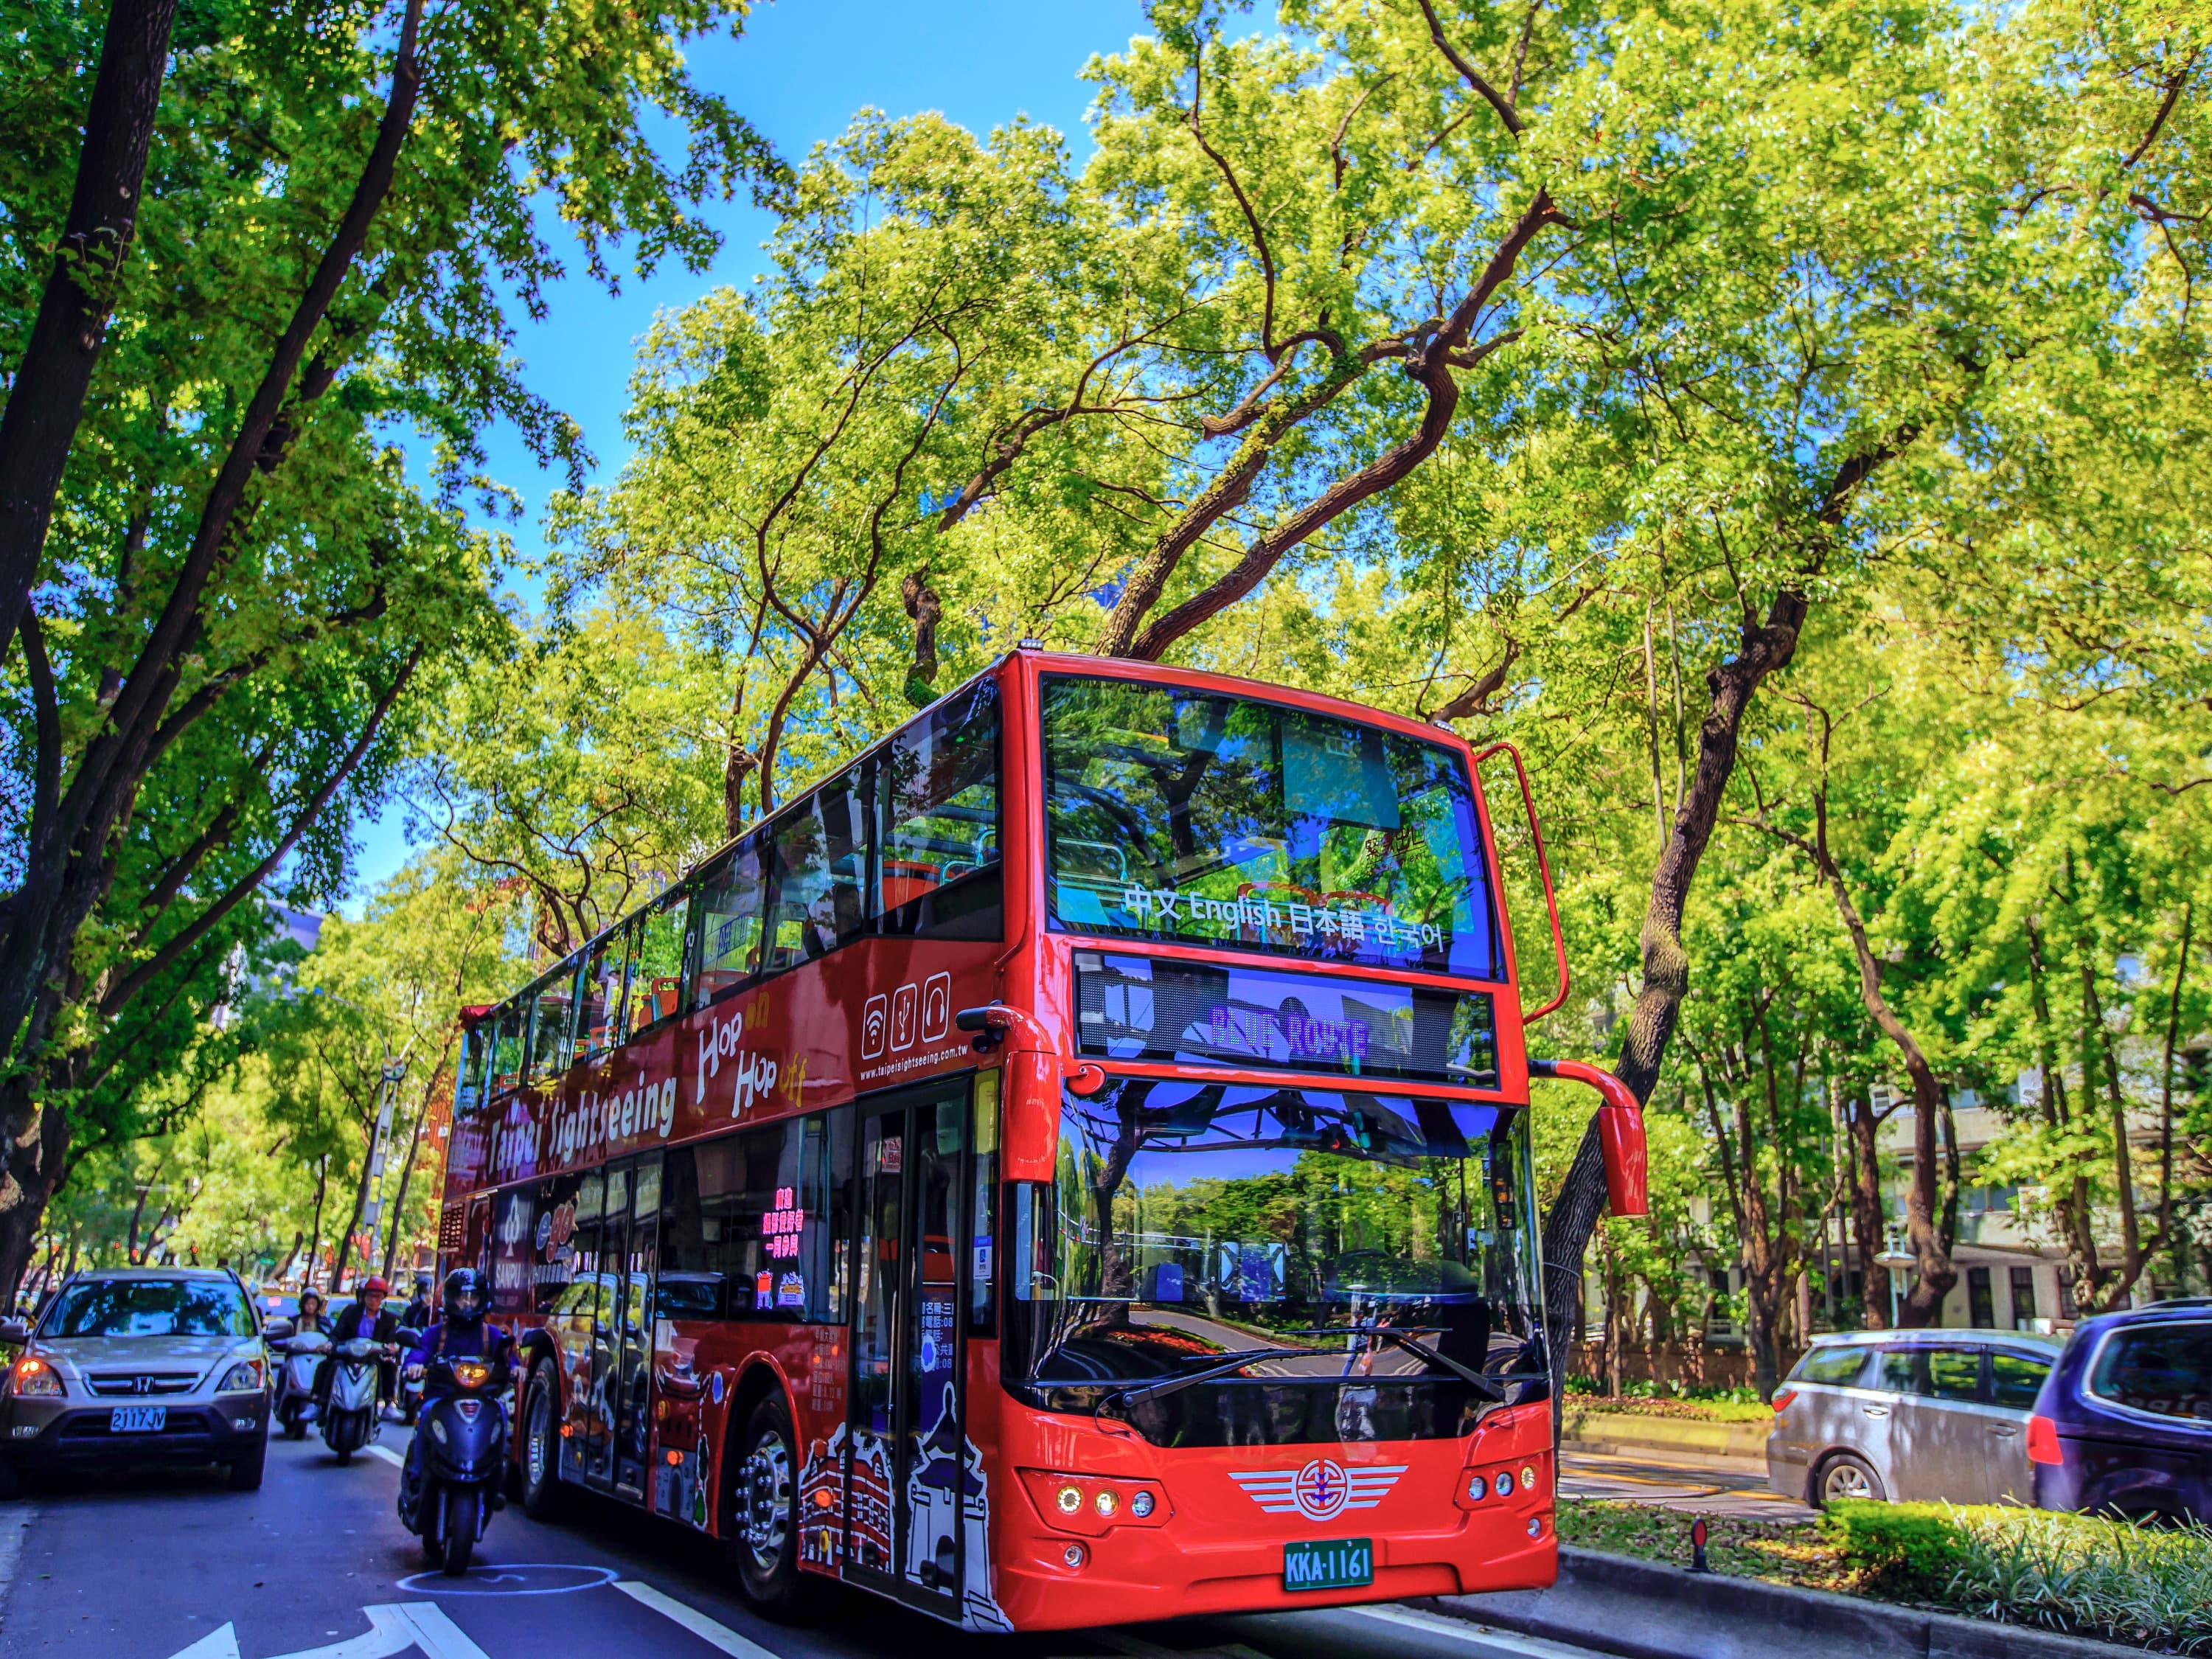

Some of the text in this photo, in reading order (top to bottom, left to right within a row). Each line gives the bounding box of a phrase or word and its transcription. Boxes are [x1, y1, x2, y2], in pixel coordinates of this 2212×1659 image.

[1124, 888, 1444, 953] 中文 English 日本語 한국어
[695, 991, 770, 1105] Hop on
[860, 1043, 969, 1082] www.taipeisightseeing.com.tw
[1210, 1005, 1368, 1059] BLUE ROUTE
[731, 1049, 808, 1119] Hop off
[489, 1069, 677, 1180] Taipei Sightseeing
[1286, 1548, 1369, 1582] KKA-1161
